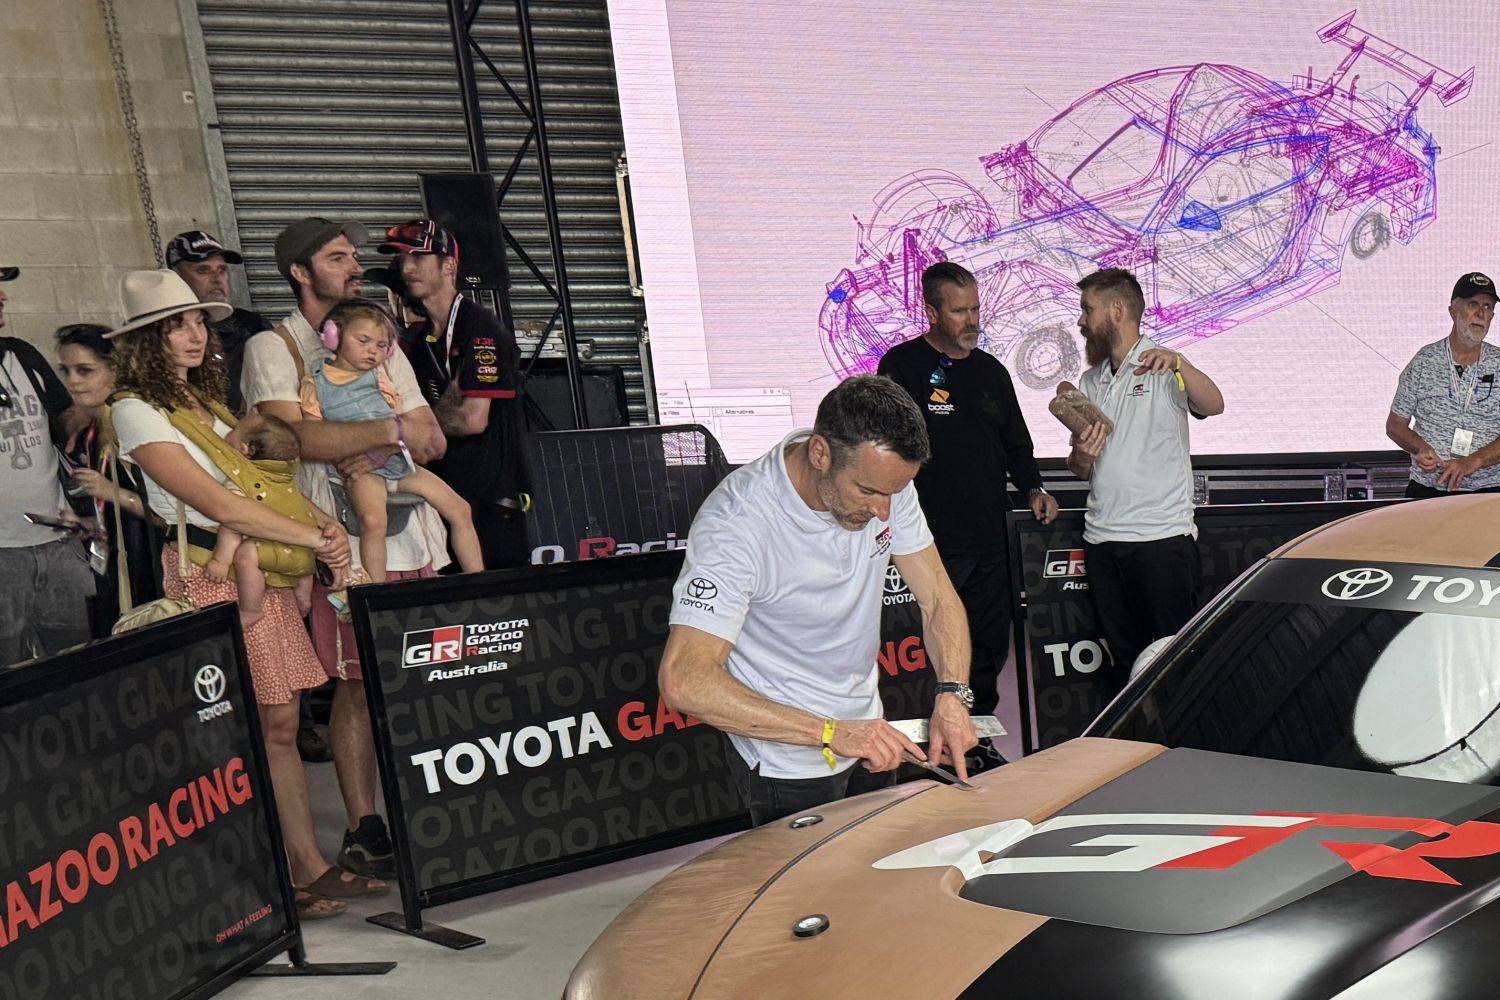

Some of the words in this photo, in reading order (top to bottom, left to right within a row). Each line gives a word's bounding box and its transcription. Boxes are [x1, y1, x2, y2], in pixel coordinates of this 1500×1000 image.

[679, 597, 715, 615] TOYOTA
[882, 592, 917, 607] OYOTA
[465, 618, 530, 636] TOYOTA
[465, 630, 524, 647] GAZOO
[405, 640, 461, 666] GR
[465, 641, 522, 657] Racing
[427, 660, 508, 683] Australia
[197, 700, 234, 723] TOYOTA
[411, 711, 613, 794] TOYOTA
[0, 832, 121, 948] AZOO
[118, 756, 254, 870] RACING
